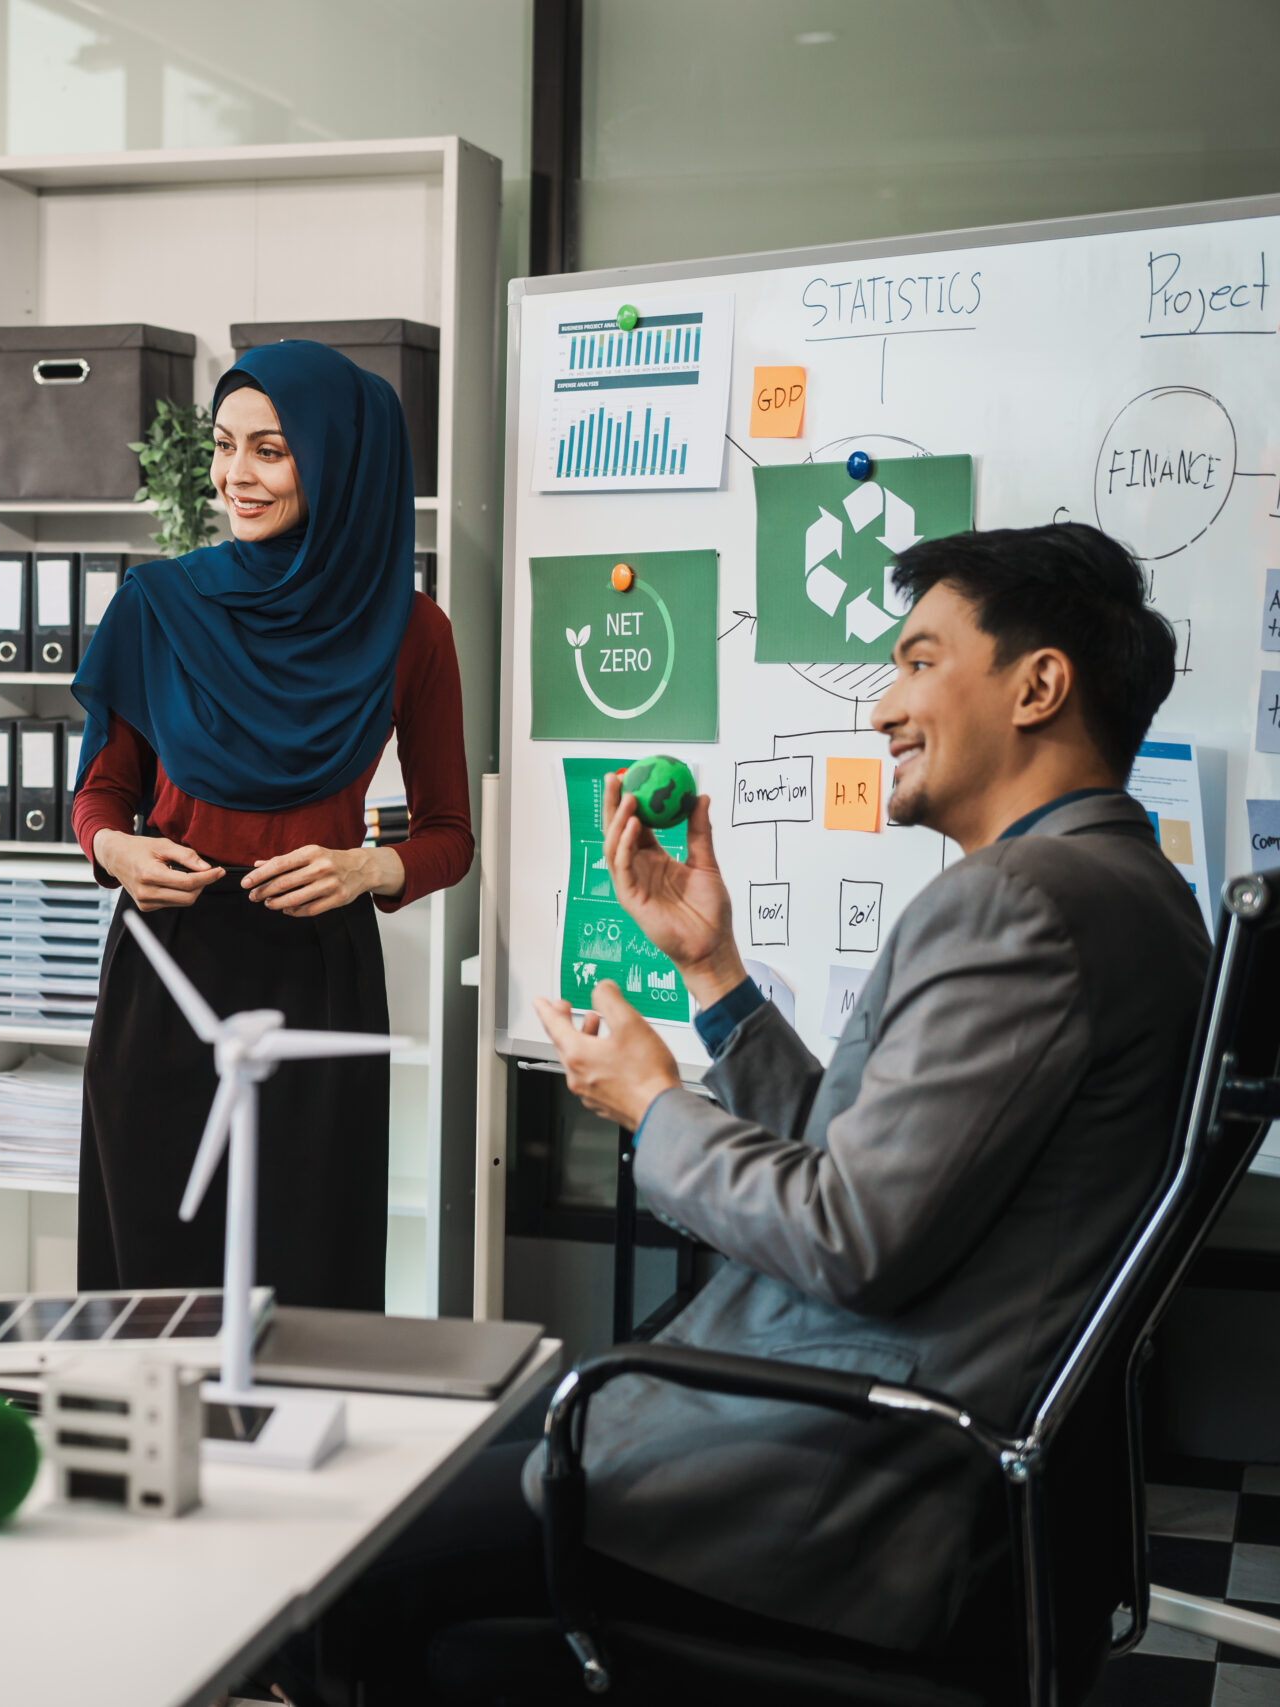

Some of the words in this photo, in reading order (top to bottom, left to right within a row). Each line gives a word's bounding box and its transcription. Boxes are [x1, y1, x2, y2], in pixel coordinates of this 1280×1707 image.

[802, 271, 982, 327] STATISTICS
[1148, 251, 1270, 335] Project
[757, 384, 804, 412] GDP
[1108, 448, 1222, 495] FINANCE
[606, 612, 644, 637] NET
[599, 647, 652, 673] ZERO
[738, 774, 807, 804] Promotion
[834, 782, 868, 806] H.R
[758, 903, 784, 920] 100%
[848, 901, 876, 927] 20%
